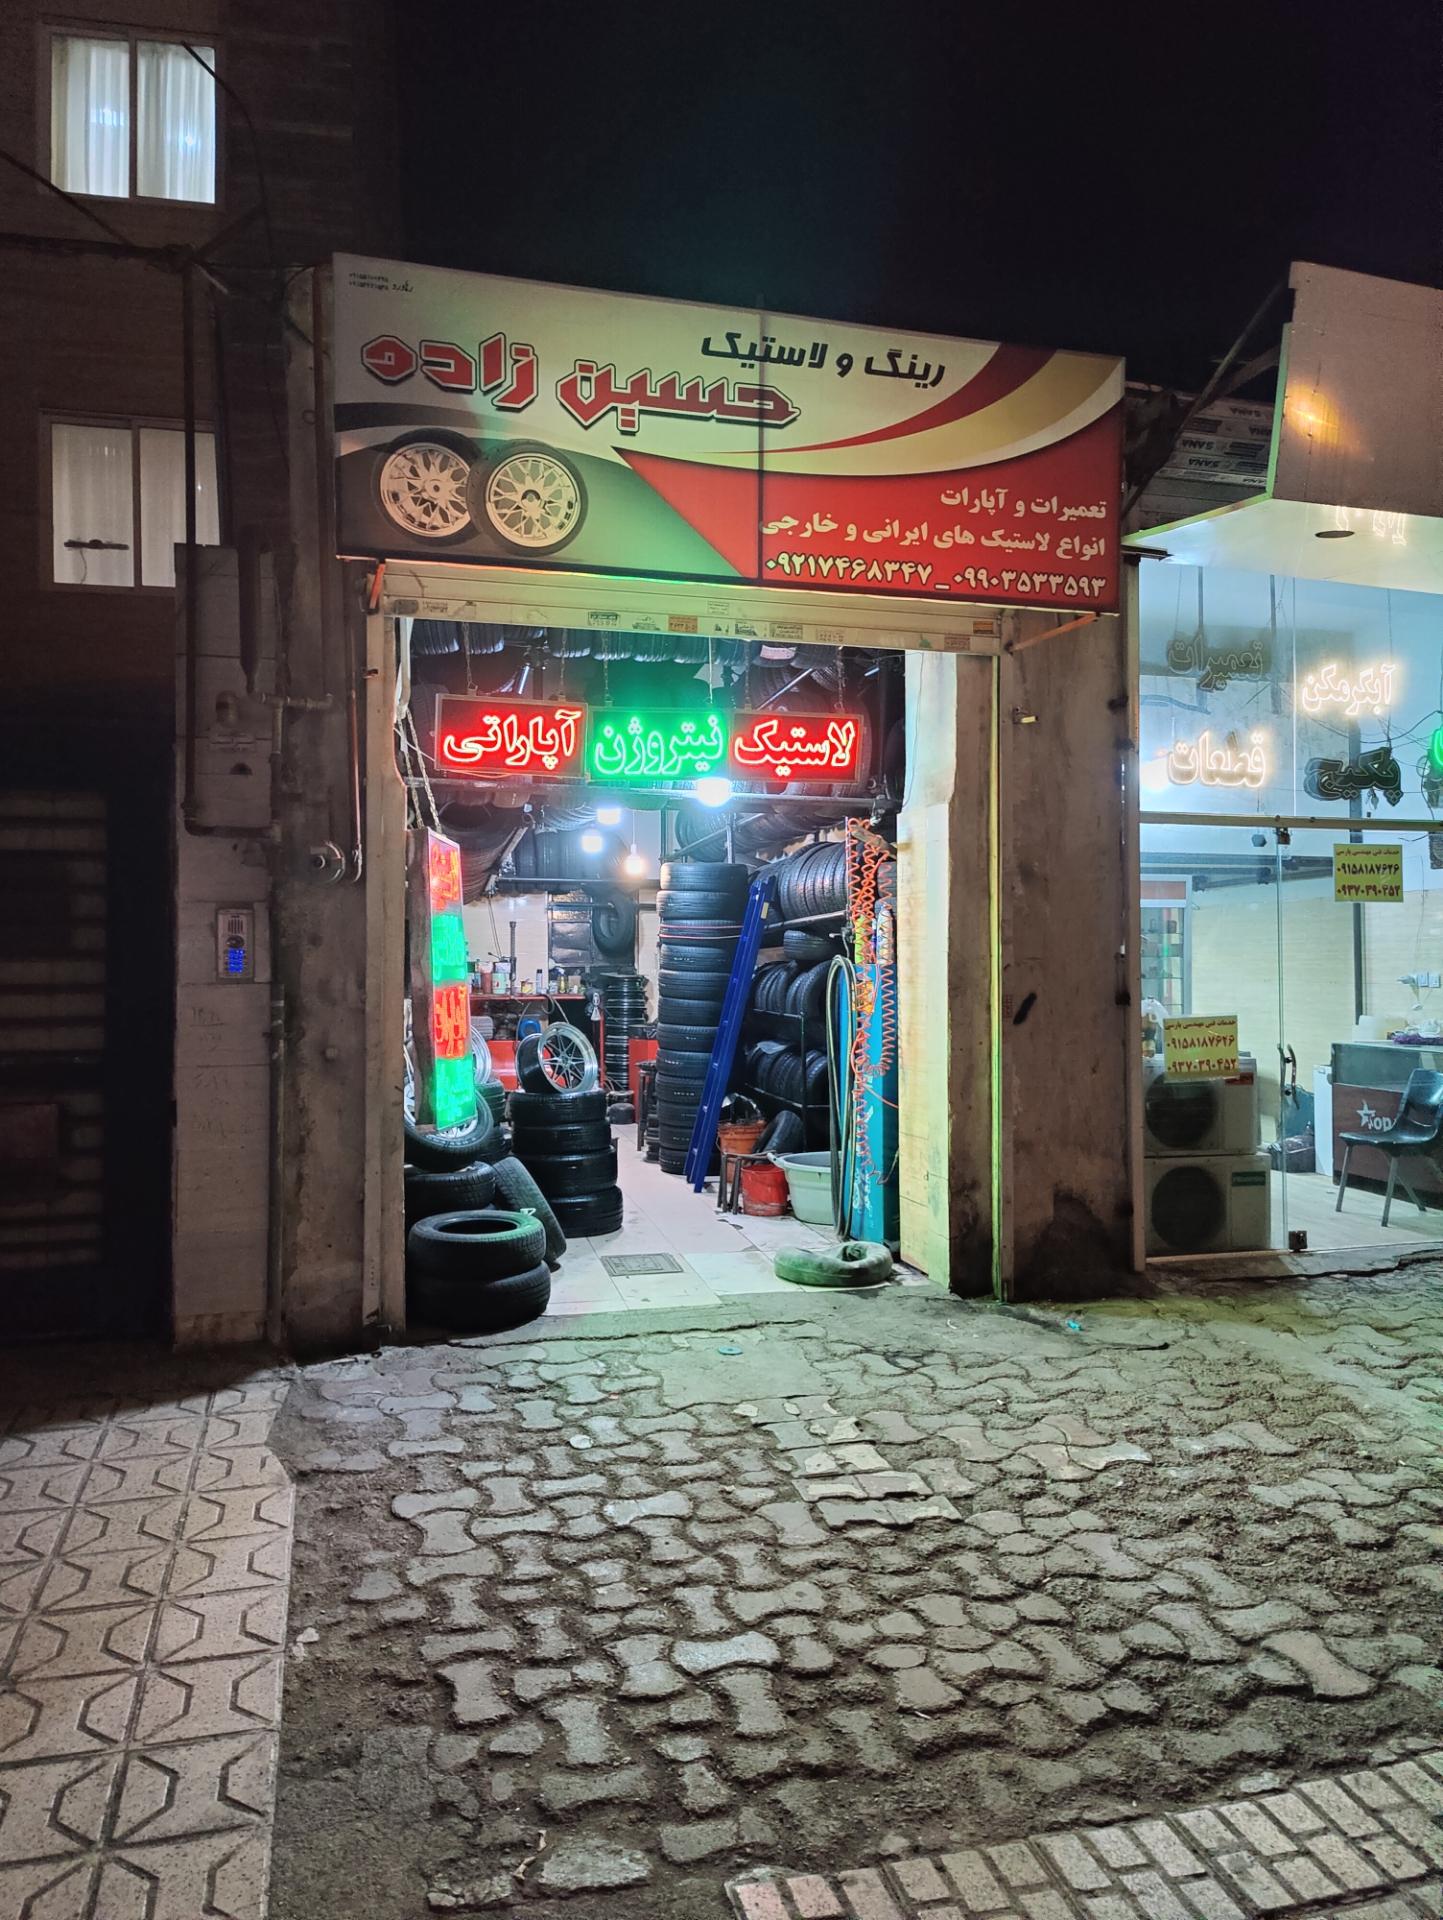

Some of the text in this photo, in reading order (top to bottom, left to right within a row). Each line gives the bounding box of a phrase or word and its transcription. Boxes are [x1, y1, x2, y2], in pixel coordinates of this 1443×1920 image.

[361, 332, 801, 434] حسین زاده
[701, 332, 946, 389] رینگ و لاستیک
[940, 487, 1107, 521] تعمیرات و آپارات
[760, 512, 1105, 560] انواع لاستیک های ایرانی و خارجی
[765, 551, 933, 586] ۰۹۲۱۷۴۶۸۳۴۷
[953, 566, 1106, 597] ۰۹۹۰۳۵۳۳۵۹۳
[1168, 633, 1264, 692] تعمیرات
[443, 709, 581, 769] آپاراتی
[595, 714, 723, 775] نیتروژن
[734, 719, 856, 777] لاستیک
[1168, 730, 1266, 788] قطعات
[1303, 747, 1404, 807] پکیج
